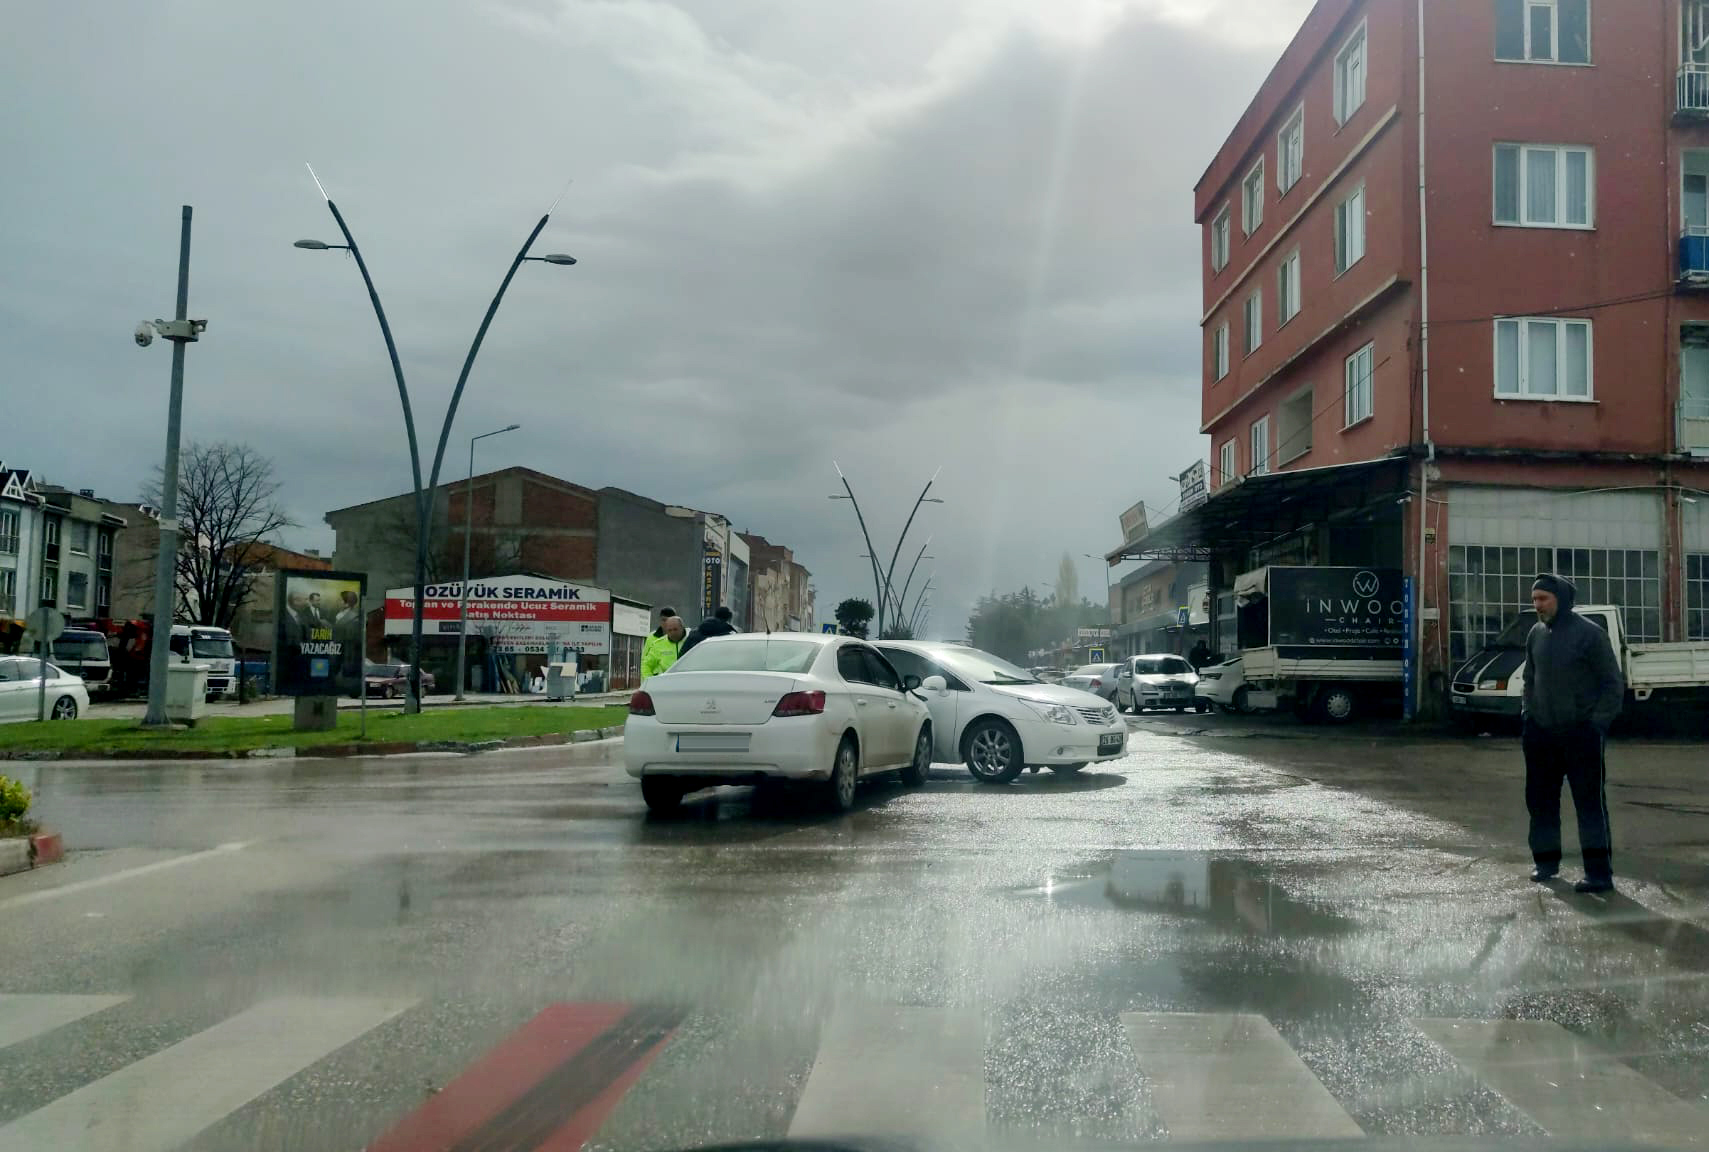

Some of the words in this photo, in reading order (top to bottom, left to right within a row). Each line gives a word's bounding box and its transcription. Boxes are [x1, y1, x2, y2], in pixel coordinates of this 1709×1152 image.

[705, 557, 720, 565] OTO
[425, 584, 499, 598] OZÜYÜK
[503, 585, 581, 600] SERAMİK
[400, 600, 438, 609] Toan
[521, 601, 548, 610] Ucuz
[550, 602, 597, 611] Seramik
[466, 611, 489, 619] atış
[492, 611, 537, 619] Noktası
[300, 641, 342, 655] YAZACAĞIZ
